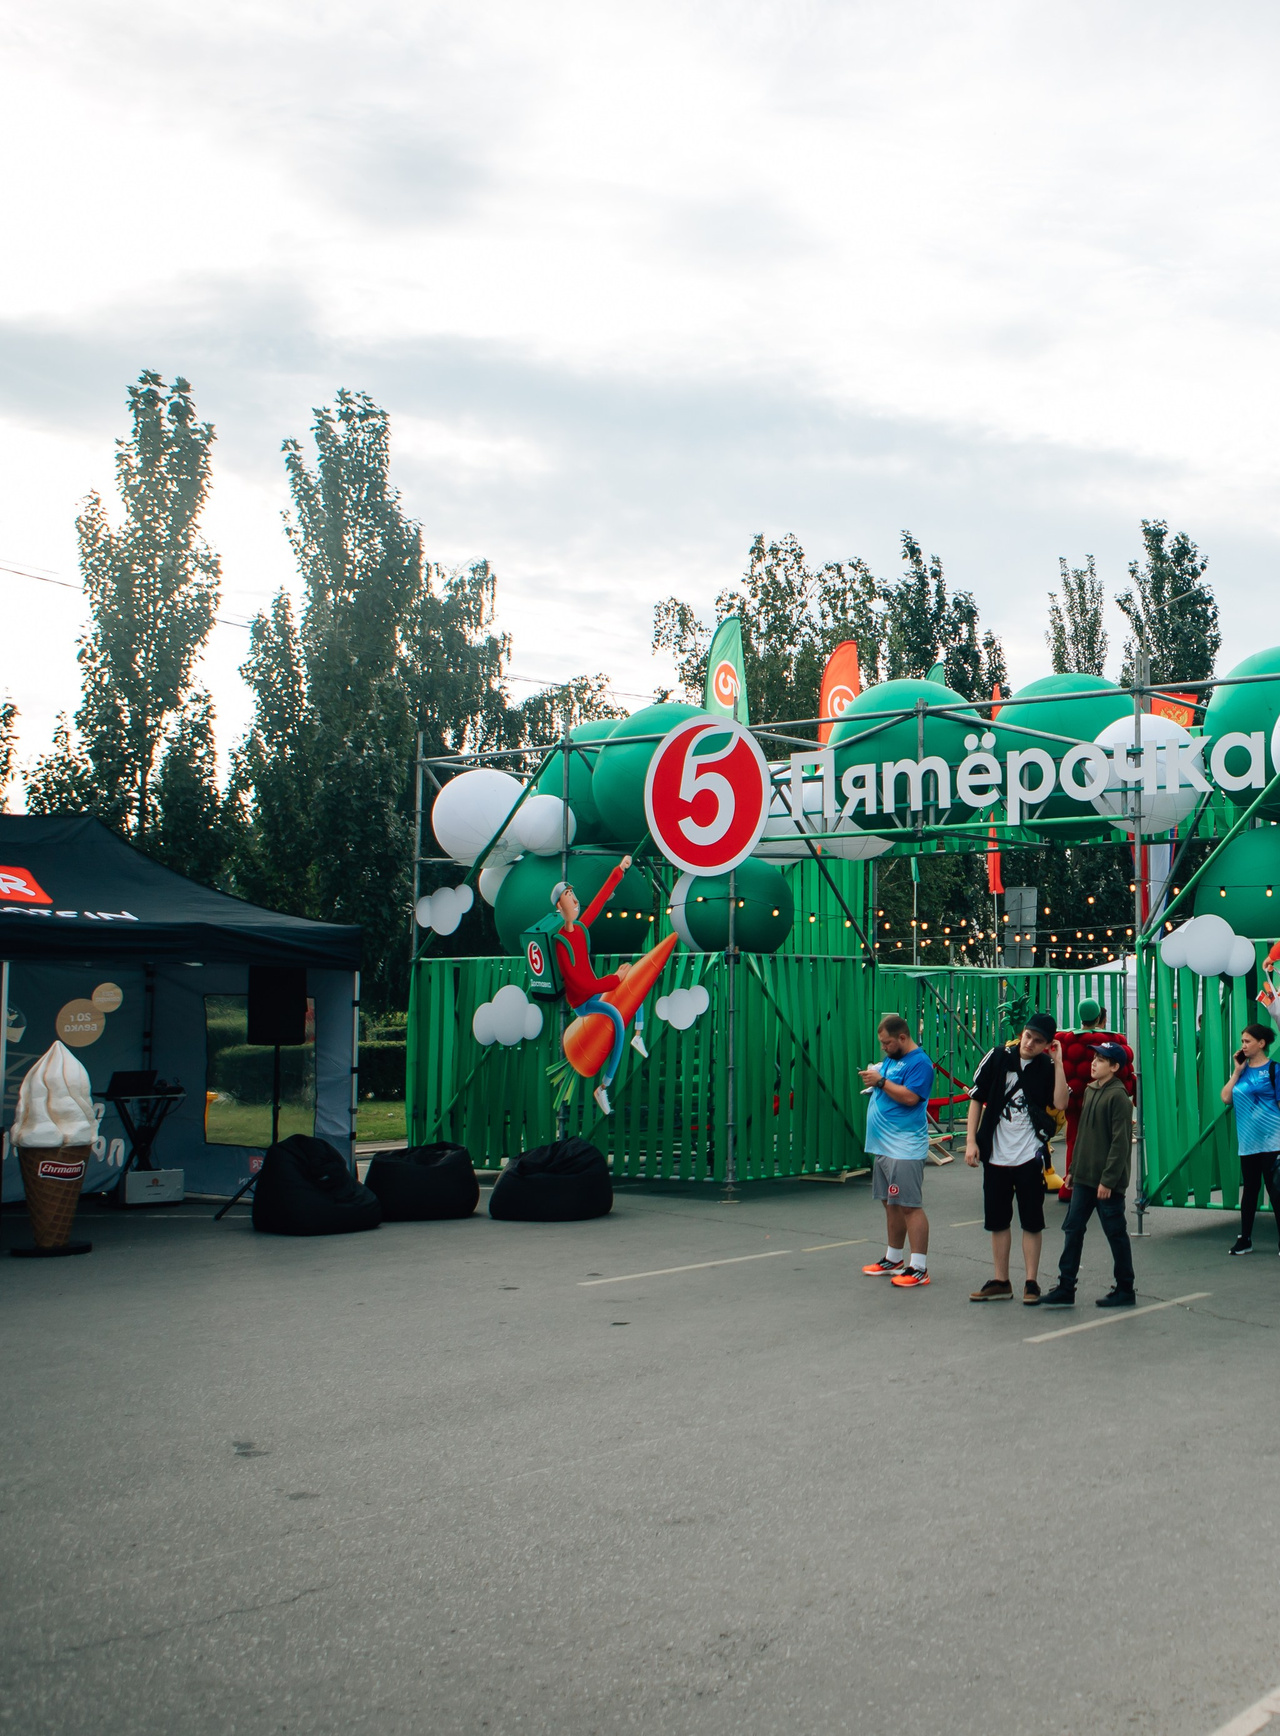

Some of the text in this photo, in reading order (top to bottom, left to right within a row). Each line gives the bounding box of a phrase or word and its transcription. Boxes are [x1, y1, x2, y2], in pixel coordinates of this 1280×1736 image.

[676, 724, 1266, 846] 5 Пятёрочка
[42, 1164, 82, 1174] Ehrmann
